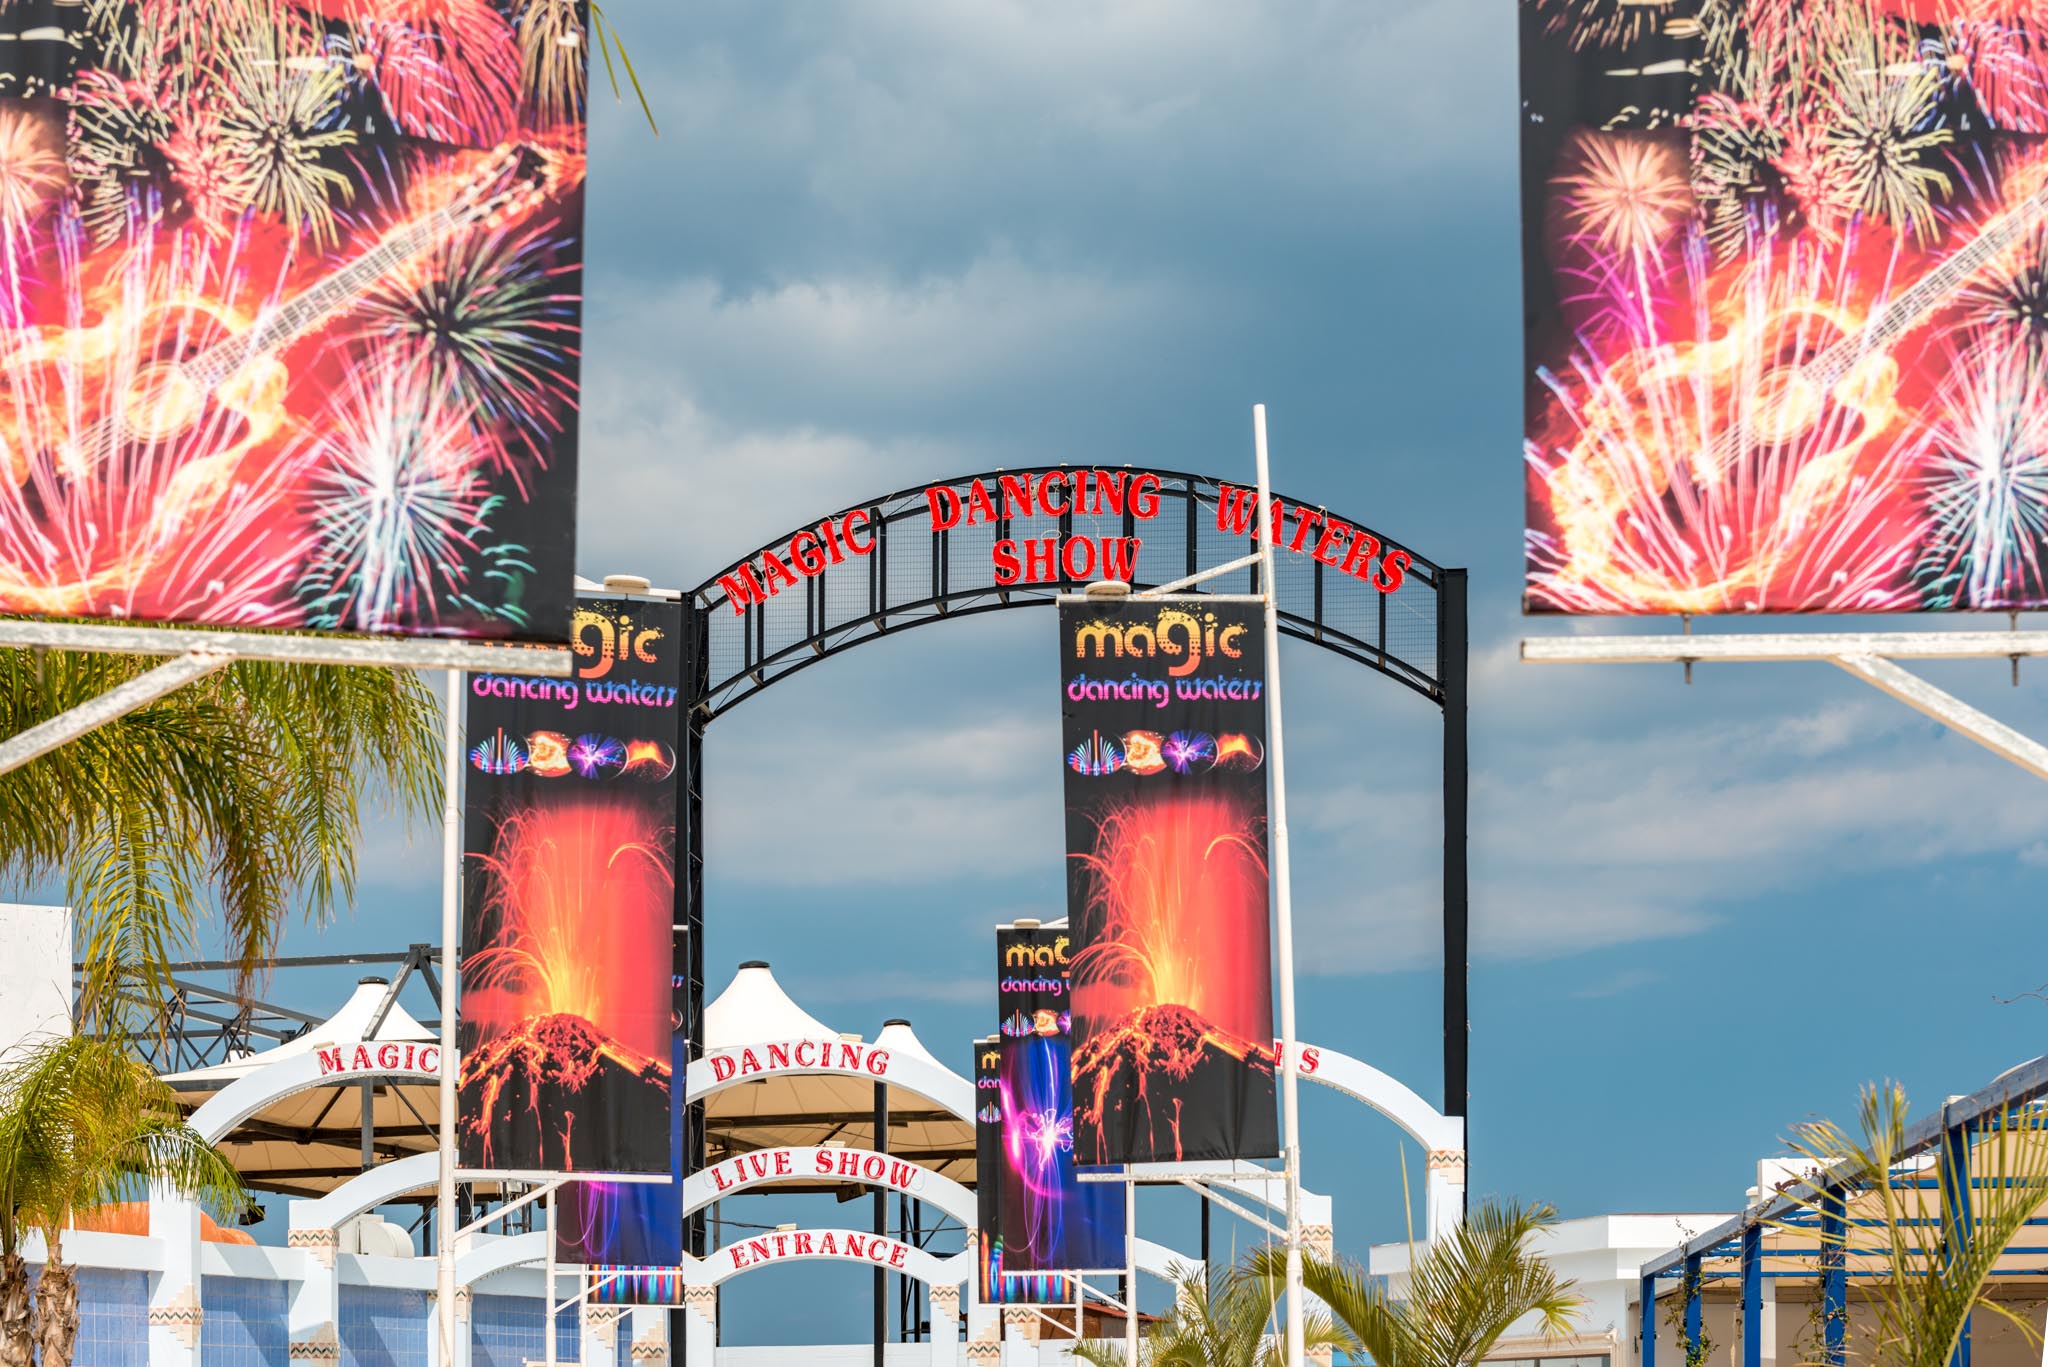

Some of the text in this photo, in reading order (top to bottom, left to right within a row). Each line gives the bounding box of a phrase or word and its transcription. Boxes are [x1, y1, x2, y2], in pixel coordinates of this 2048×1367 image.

[717, 470, 1412, 617] MAGIC DANCING WATERS
[992, 535, 1142, 585] SHOW
[1075, 601, 1247, 677] magic
[472, 673, 677, 710] dancing waters
[1067, 672, 1263, 709] dancing waters
[1000, 975, 1062, 997] dancing
[317, 1043, 439, 1075] MAGIC
[710, 1041, 890, 1083] DANCING
[711, 1149, 918, 1191] LIVE SHOW
[729, 1232, 908, 1269] ENTRANCE
